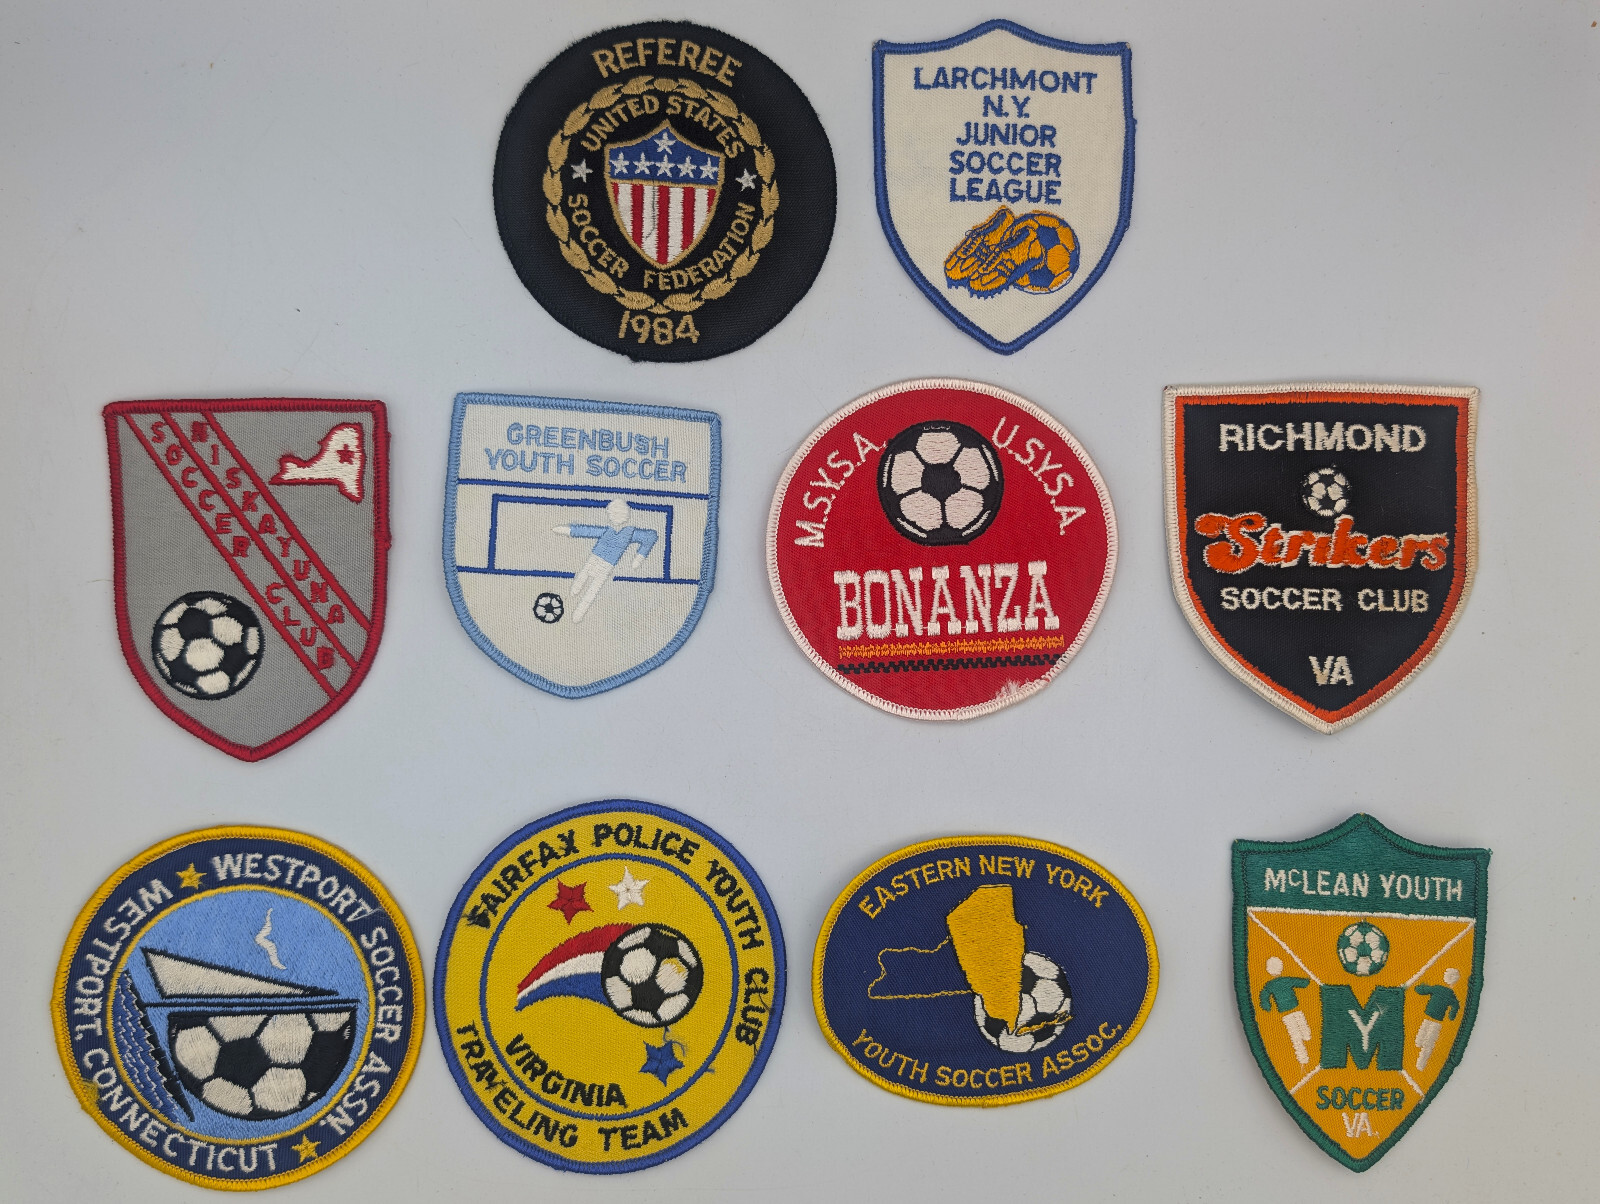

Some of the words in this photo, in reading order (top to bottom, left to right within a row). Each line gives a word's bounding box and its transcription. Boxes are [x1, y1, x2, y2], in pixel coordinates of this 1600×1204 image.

[592, 38, 742, 87] REFEREE
[914, 67, 1097, 94] LARCHMONT
[581, 96, 659, 152] UNITED
[666, 96, 745, 158] STATES
[983, 95, 1031, 118] N.Y.
[956, 122, 1056, 148] JUNIOR
[949, 151, 1062, 177] SOCCER
[950, 178, 1062, 205] LEAGUE
[568, 194, 629, 278] SOCCER
[644, 202, 755, 290] FEDERATION
[619, 311, 700, 345] 1984
[507, 423, 668, 458] GREENBUSH
[1219, 422, 1426, 452] RICHMOND
[485, 448, 574, 475] YOUTH
[586, 455, 686, 483] SOCCER
[152, 421, 249, 558] SOCCER
[266, 583, 335, 669] CLUB
[191, 421, 344, 625] NISKAYUNA
[1195, 514, 1448, 574] Strikers
[834, 560, 1060, 641] BONANZA
[1220, 588, 1342, 611] SOCCER
[1358, 589, 1428, 613] CLUB
[1309, 656, 1353, 686] VA
[858, 858, 971, 919] EASTERN
[979, 855, 1035, 878] NEW
[1046, 864, 1109, 908] YORK
[1264, 868, 1370, 897] McLEAN
[1380, 871, 1462, 901] YOUTH
[213, 854, 374, 922] WESTPORT
[361, 927, 403, 1043] SOCCER
[464, 829, 579, 929] FAIRFAX
[592, 822, 700, 864] POLICE
[704, 859, 764, 950] YOUTH
[735, 968, 769, 1046] CLUB
[505, 1034, 627, 1108] VIRGINIA
[852, 1029, 929, 1084] YOUTH
[935, 1062, 1032, 1089] SOCCER
[1042, 1022, 1122, 1079] ASSOC.
[84, 1049, 277, 1172] CONNECTICUT
[457, 1021, 578, 1148] TRAVELING
[598, 1108, 689, 1151] TEAM
[1316, 1085, 1404, 1111] SOCCER
